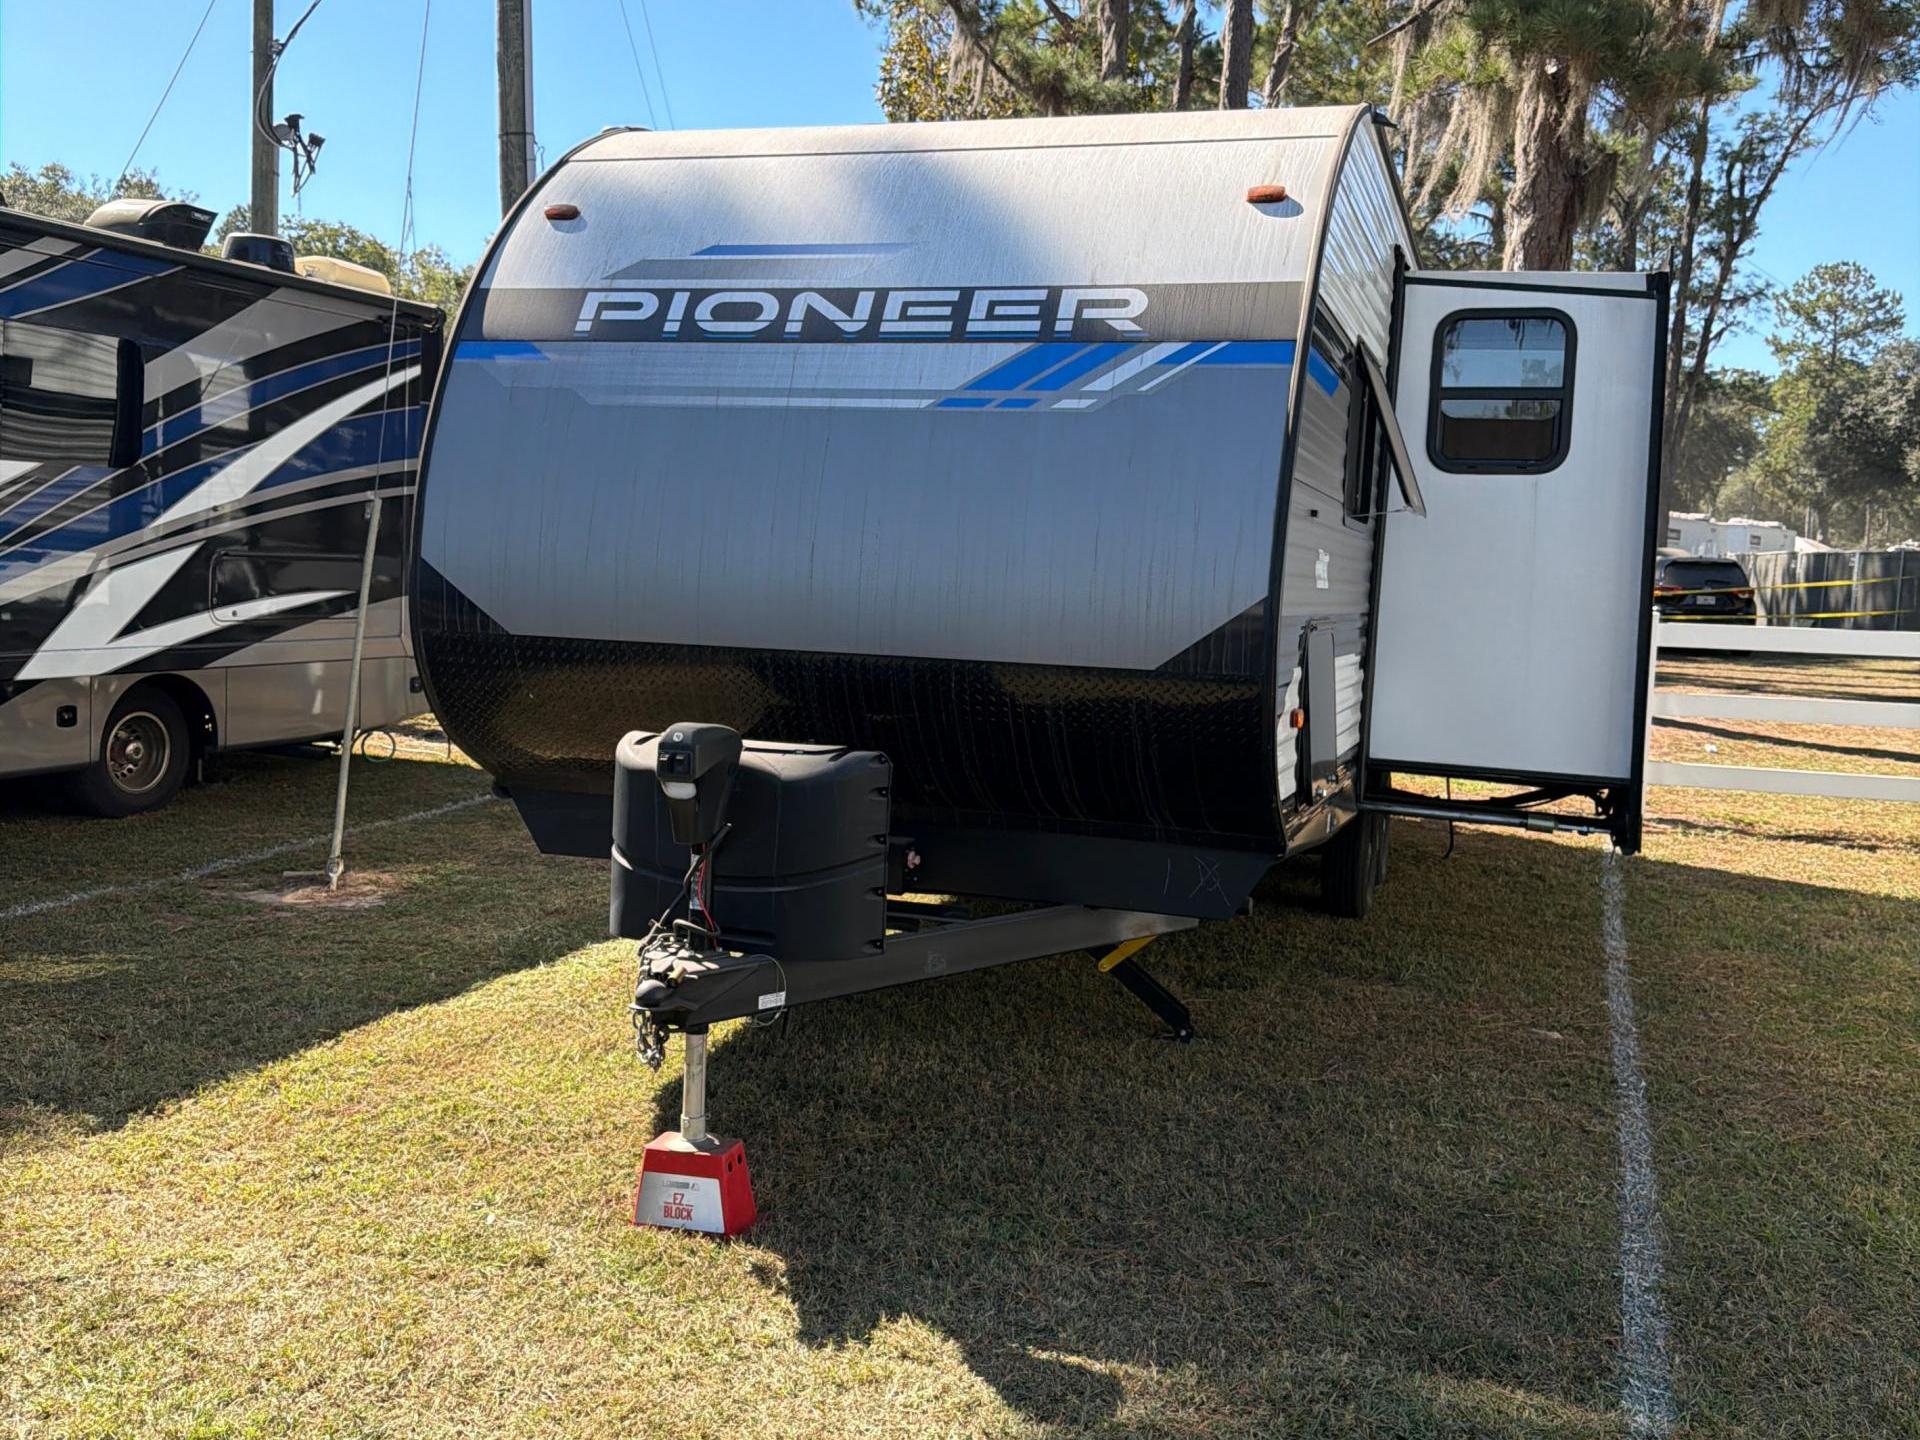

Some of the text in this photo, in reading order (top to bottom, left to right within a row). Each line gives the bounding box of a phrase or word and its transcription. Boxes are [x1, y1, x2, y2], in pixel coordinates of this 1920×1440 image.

[574, 287, 1149, 337] PIONEER
[672, 1192, 685, 1206] EZ
[663, 1205, 693, 1221] BLOCK
